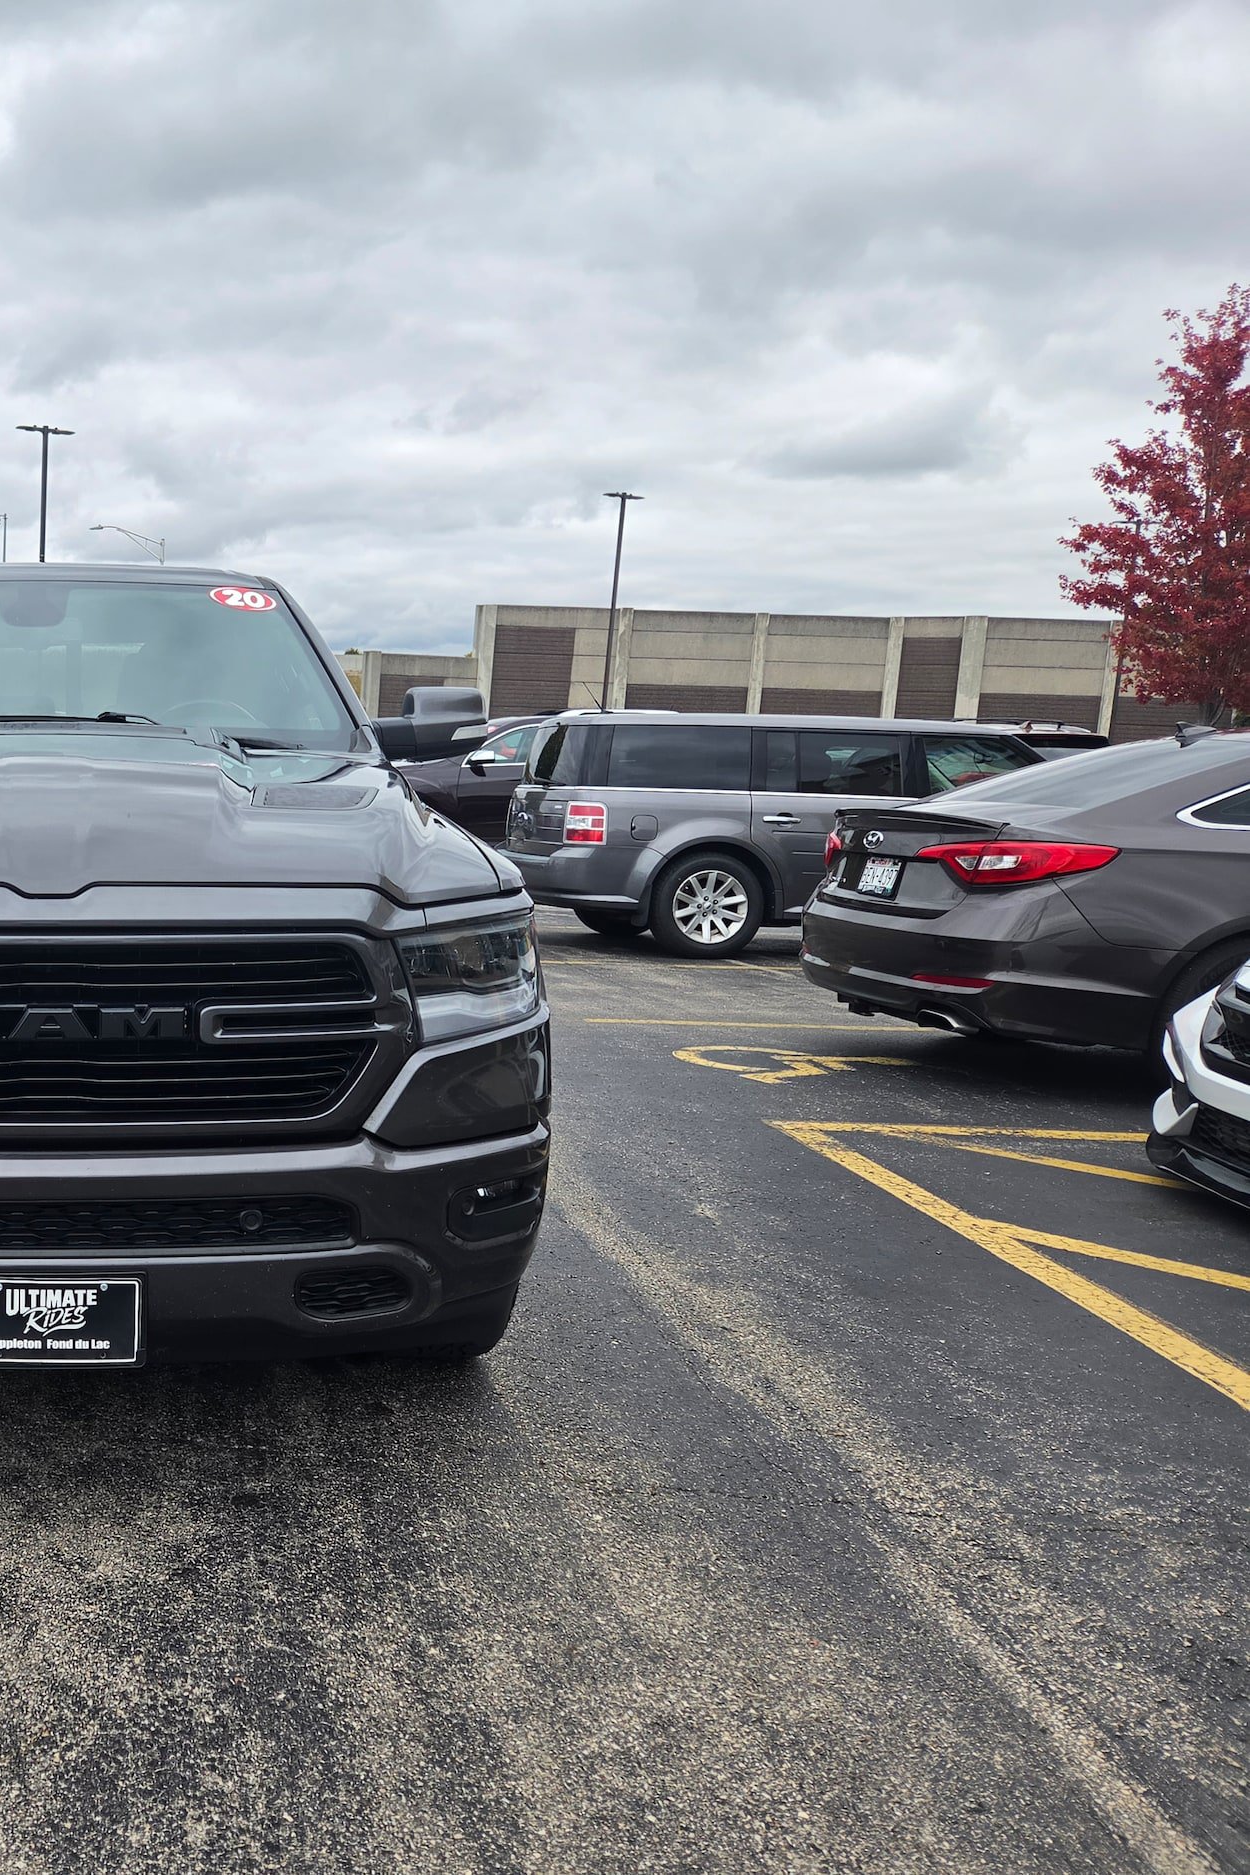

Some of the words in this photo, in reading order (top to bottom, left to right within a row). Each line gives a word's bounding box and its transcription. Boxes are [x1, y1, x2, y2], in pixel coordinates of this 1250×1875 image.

[222, 589, 265, 608] 20
[5, 1288, 98, 1316] ULTIMATE
[46, 1338, 74, 1350] Fond
[75, 1339, 90, 1350] du
[91, 1339, 111, 1350] Lac
